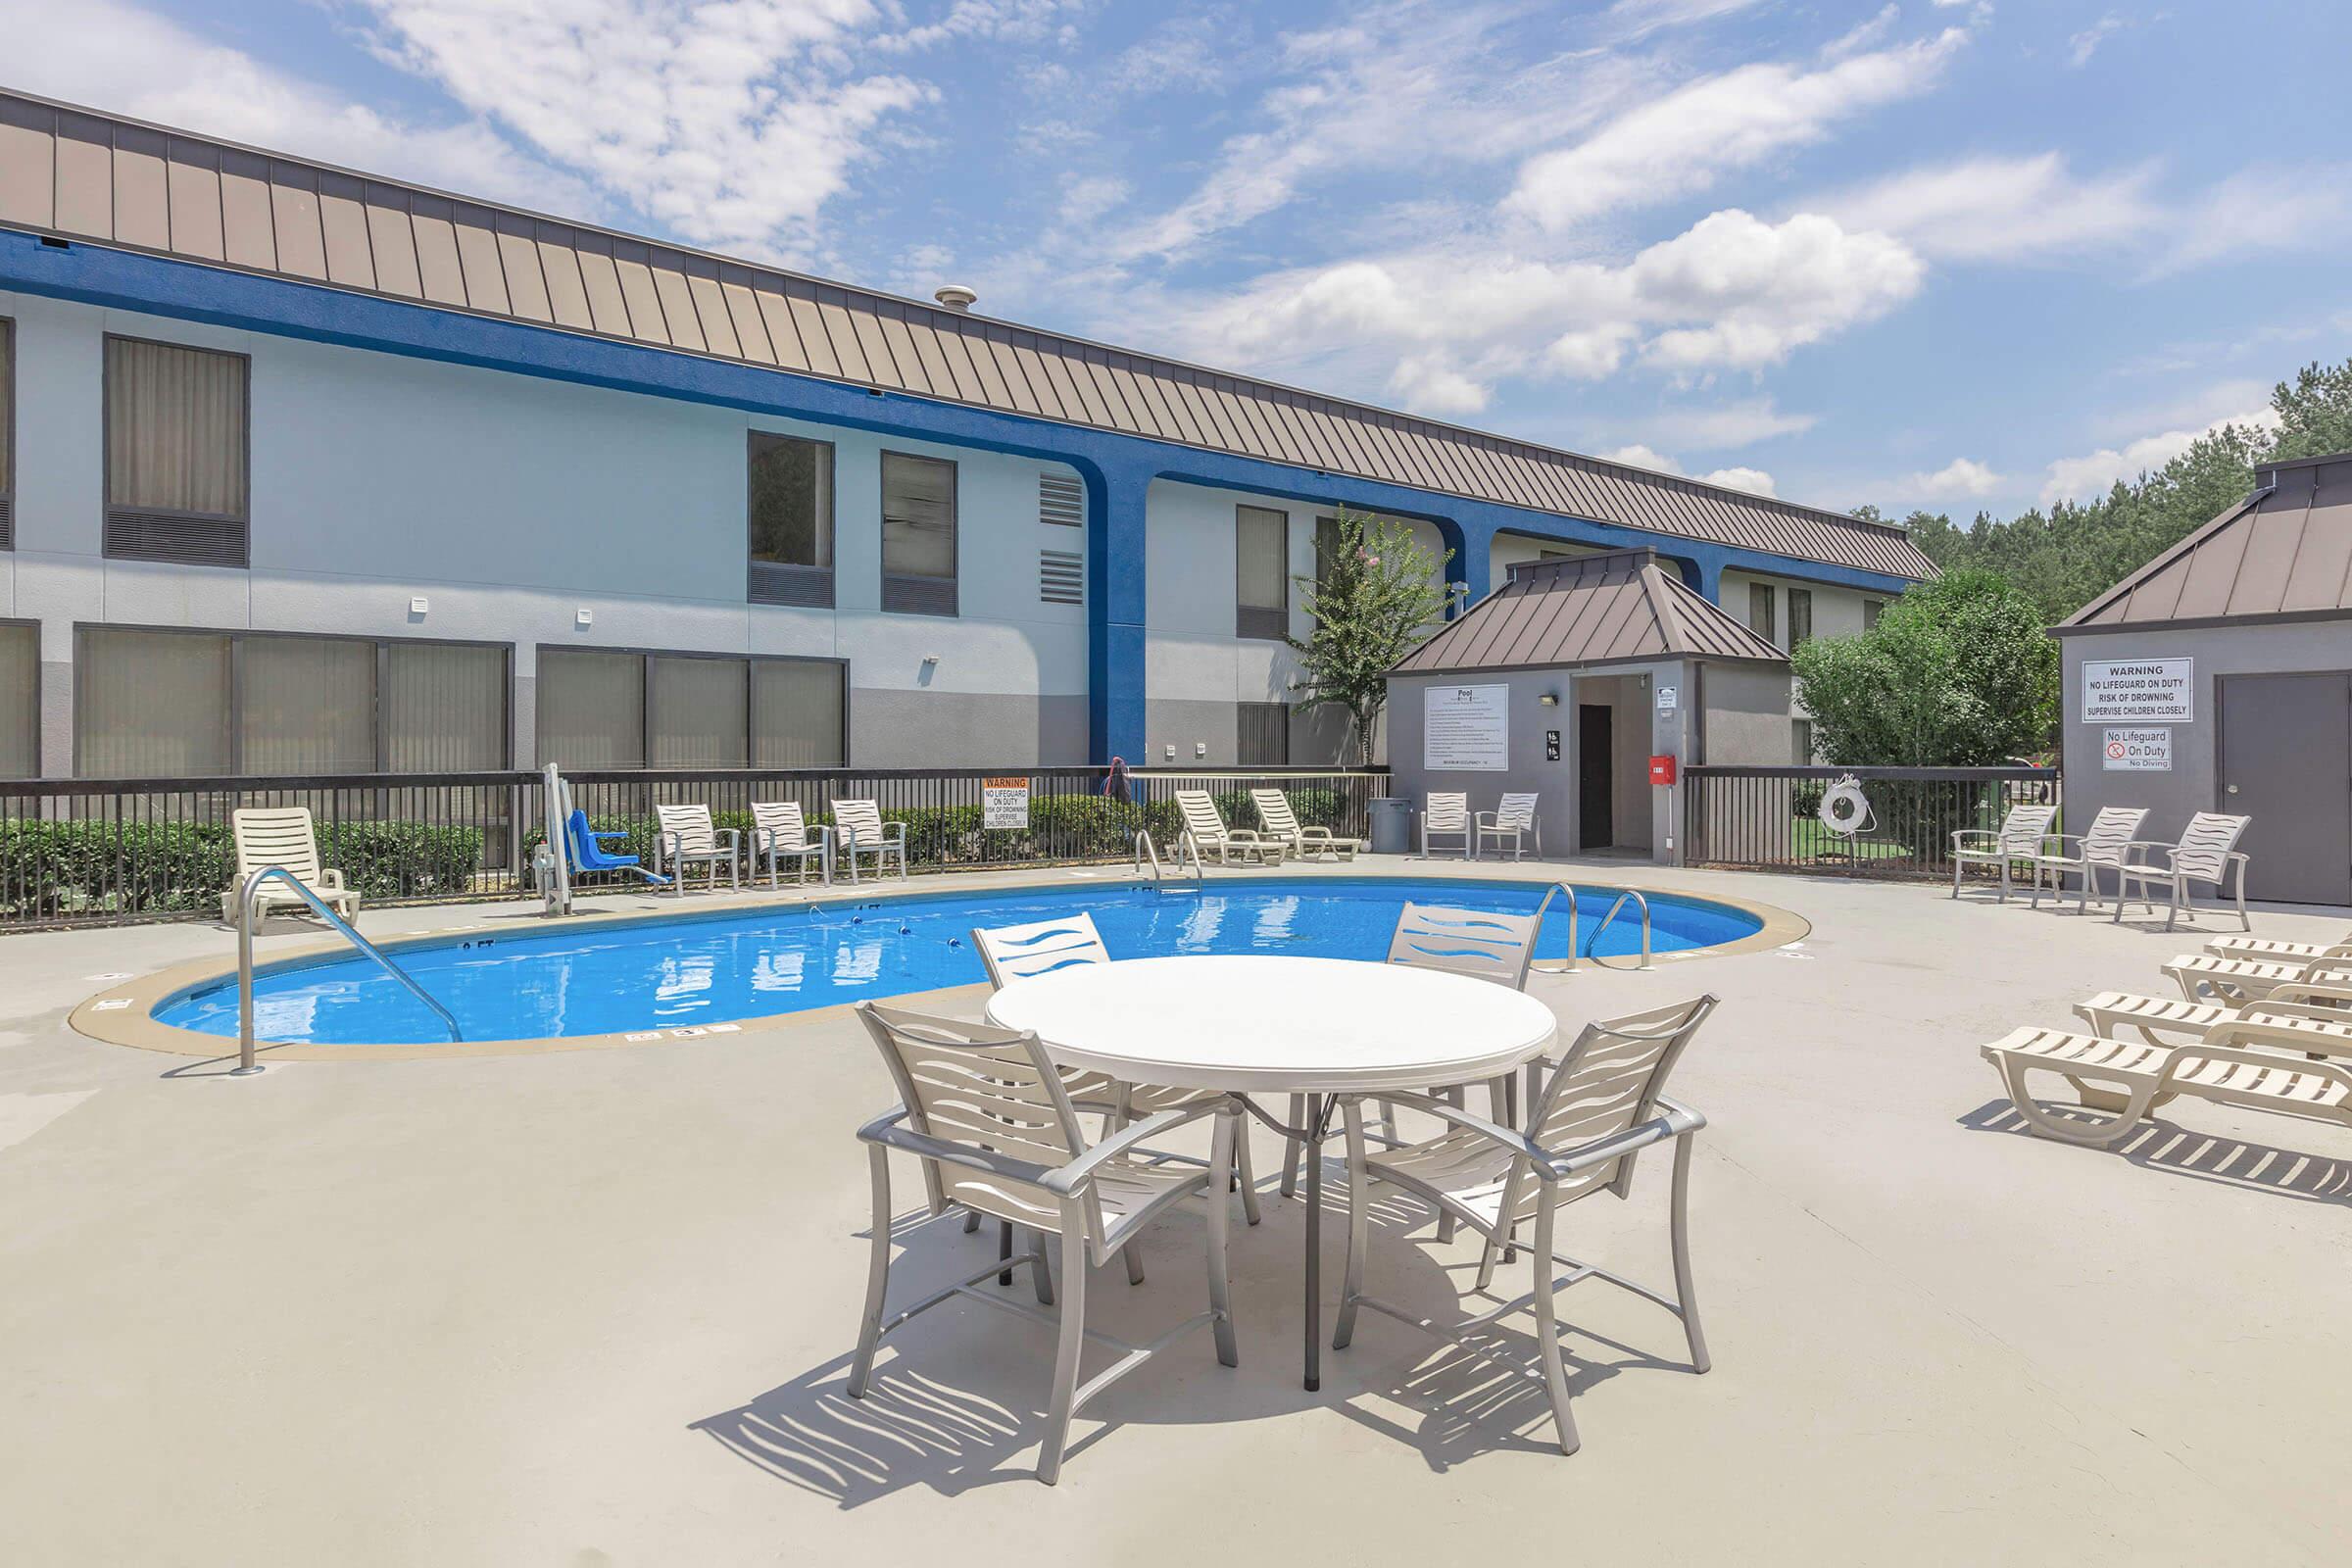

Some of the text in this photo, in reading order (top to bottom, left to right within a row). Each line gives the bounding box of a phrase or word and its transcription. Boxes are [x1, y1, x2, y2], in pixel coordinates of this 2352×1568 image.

[2109, 665, 2164, 675] WARNING
[2089, 678, 2183, 690] NO LIFEGUARD ON DUTY
[2098, 692, 2175, 703] RISK OF DROWNING
[2087, 706, 2187, 716] SUPERVISE CHILDREN CLOSELY
[2108, 730, 2166, 744] No Lifeguard
[2129, 745, 2166, 759] On Duty
[2142, 760, 2168, 768] Diving
[986, 778, 1026, 787] WARNING
